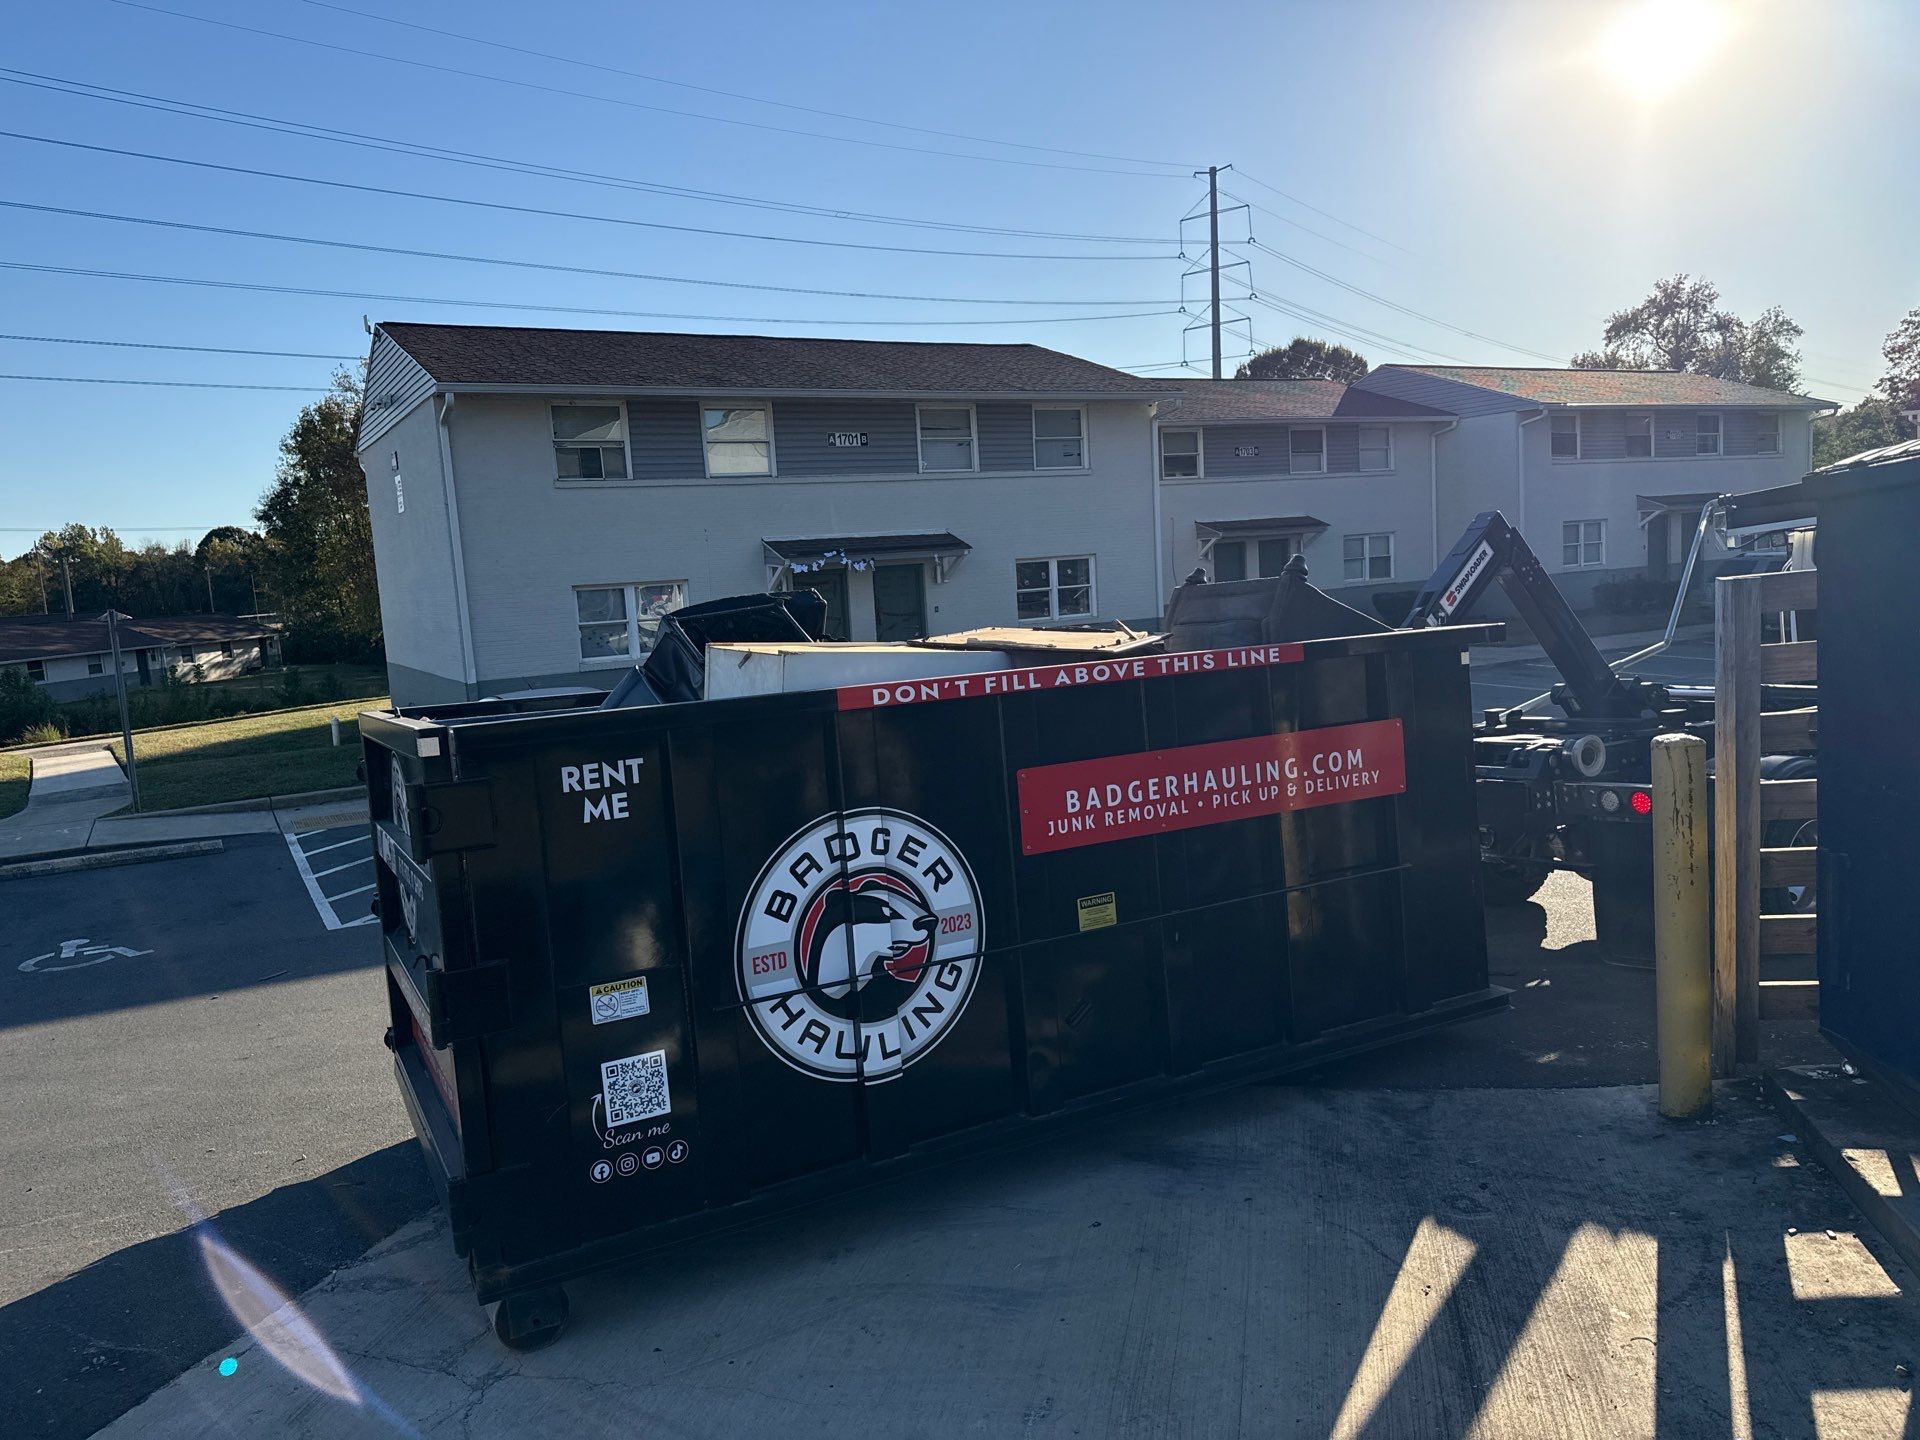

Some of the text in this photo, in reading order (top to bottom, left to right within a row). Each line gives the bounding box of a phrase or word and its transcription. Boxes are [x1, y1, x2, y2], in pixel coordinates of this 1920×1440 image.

[829, 433, 867, 445] A 1701 B
[1454, 549, 1488, 594] SWAPLOADER
[872, 647, 1280, 706] DON'T FILL ABOVE THIS LINE
[561, 757, 644, 793] RENT
[1066, 748, 1363, 813] BADGERHAULING.COM
[583, 792, 630, 823] ME
[1048, 770, 1380, 836] JUNK REMOVAL PICK UP & DELIVERY
[763, 827, 954, 923] BADGER
[1080, 895, 1112, 908] WARNING
[940, 913, 972, 935] 2023
[752, 951, 788, 975] ESTD
[603, 979, 643, 993] CAUTION
[768, 961, 963, 1063] HAULING
[603, 1122, 671, 1149] Scan me
